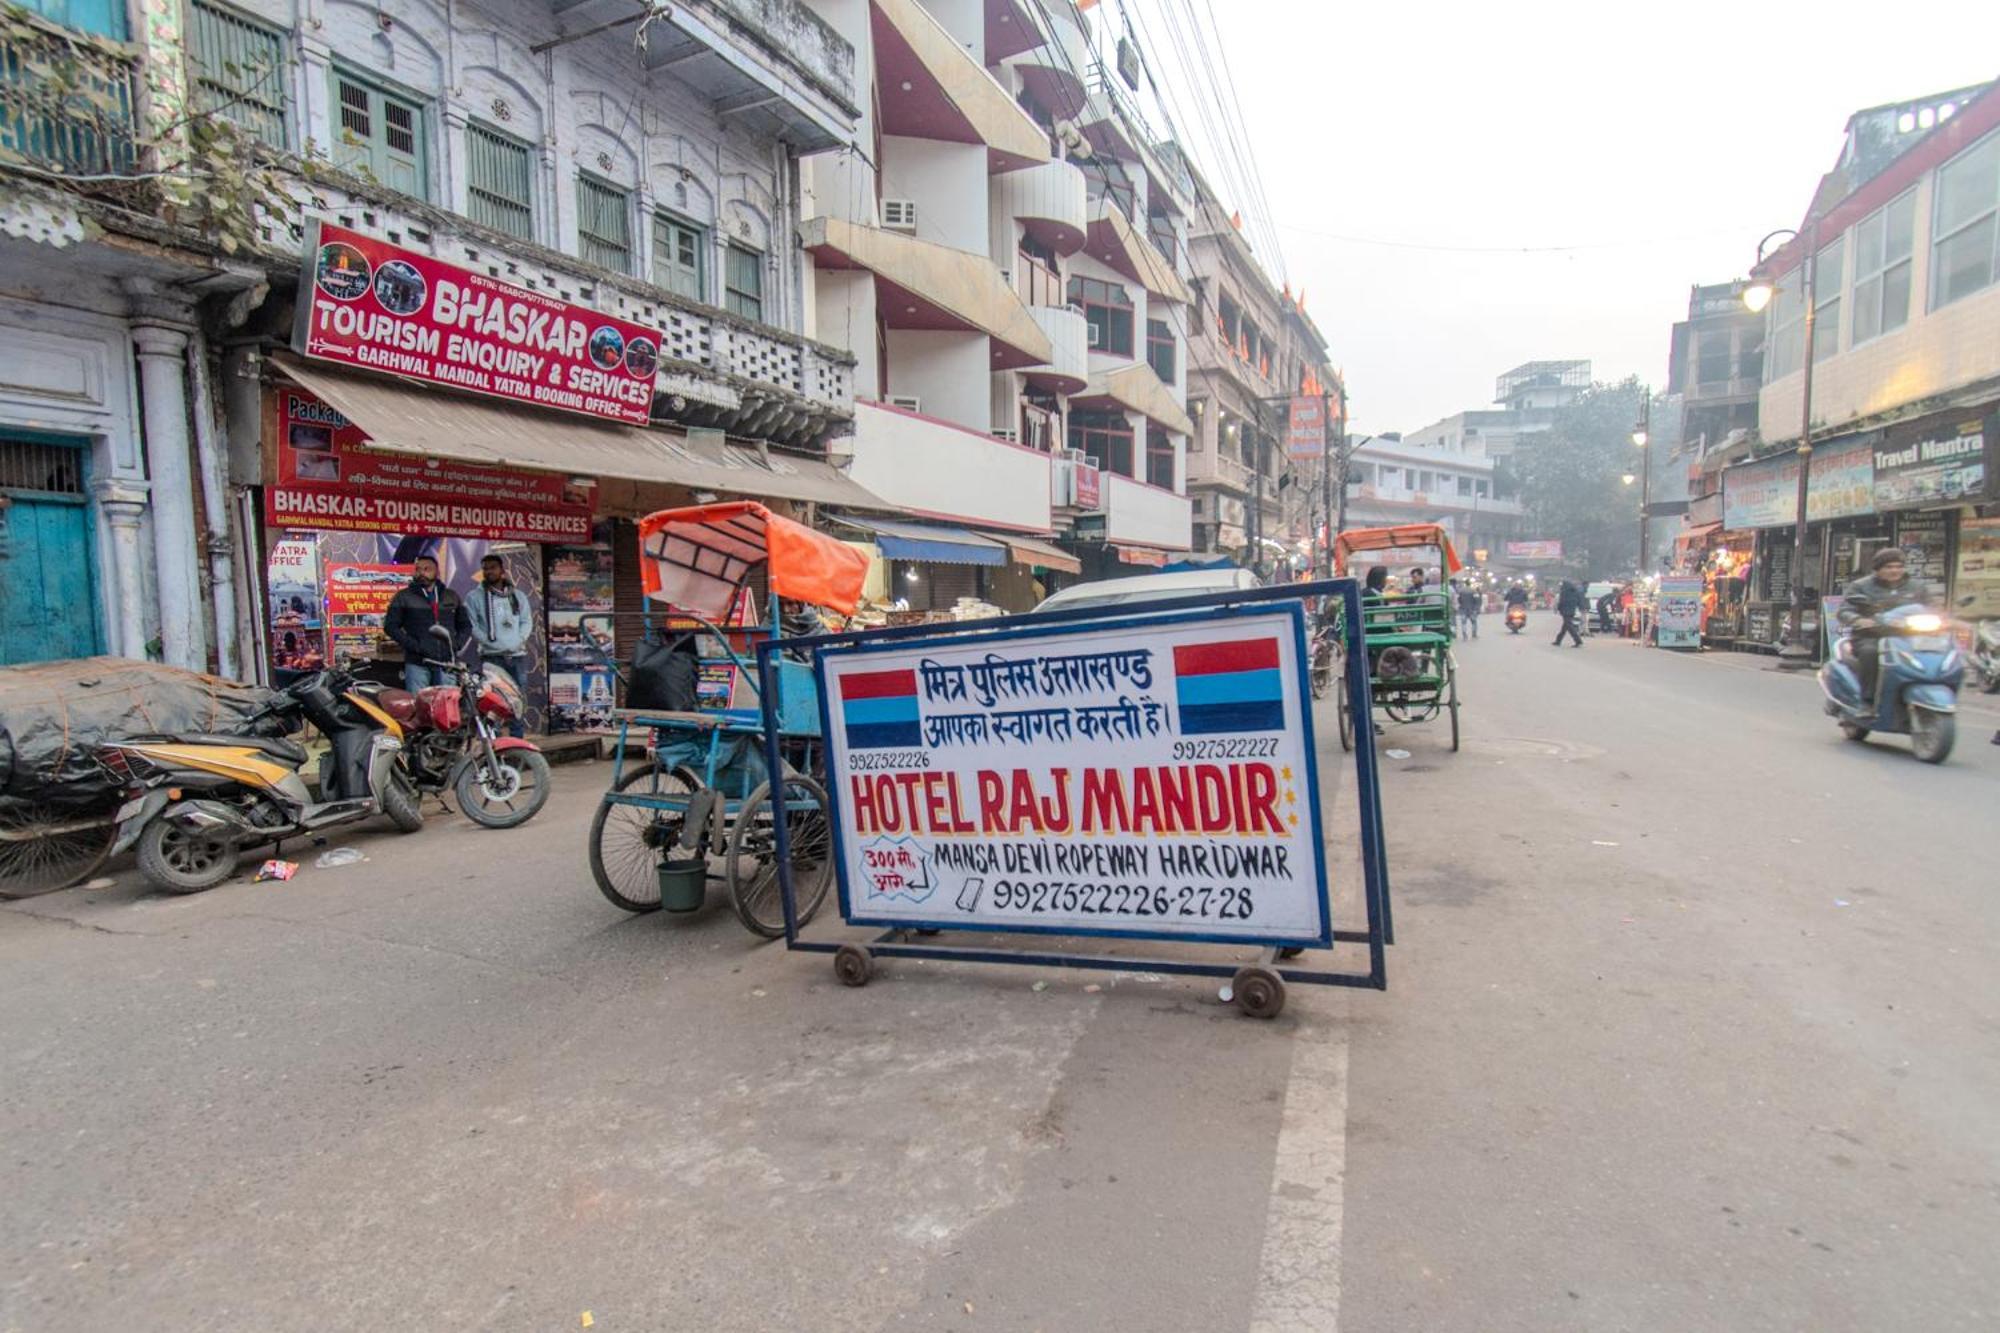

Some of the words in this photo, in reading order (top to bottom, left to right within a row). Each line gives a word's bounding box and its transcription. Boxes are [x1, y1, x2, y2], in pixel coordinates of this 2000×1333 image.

[432, 280, 588, 360] BHASKAR
[316, 299, 440, 357] TOURISM
[446, 333, 545, 380] ENQUIRY
[549, 363, 562, 385] &
[567, 365, 651, 406] SERVICES
[357, 345, 430, 377] GARHWAL
[435, 363, 490, 389] MANDAL
[494, 375, 531, 398] YATRA
[534, 383, 583, 408] BOOKING
[585, 396, 622, 417] OFFICE
[1874, 444, 1919, 470] Travel
[1921, 434, 1984, 460] Mantra
[274, 490, 448, 523] BHASKAR-TOURISM
[528, 513, 588, 533] SERVICES
[920, 659, 967, 704] मित्र
[967, 653, 1038, 707] पुलिस
[923, 713, 990, 749] आपका
[991, 708, 1072, 746] स्वागत
[1074, 696, 1142, 745] करती
[850, 751, 930, 771] 9927522226
[1173, 737, 1279, 761] 9927522227
[851, 771, 976, 835] HOTEL
[977, 768, 1072, 835] RAJ
[1081, 761, 1289, 836] MANDIR
[865, 849, 896, 869] 300
[935, 843, 1001, 874] MANSA
[1056, 843, 1148, 878] ROPEWAY
[994, 881, 1254, 919] 9927522226-27-28
